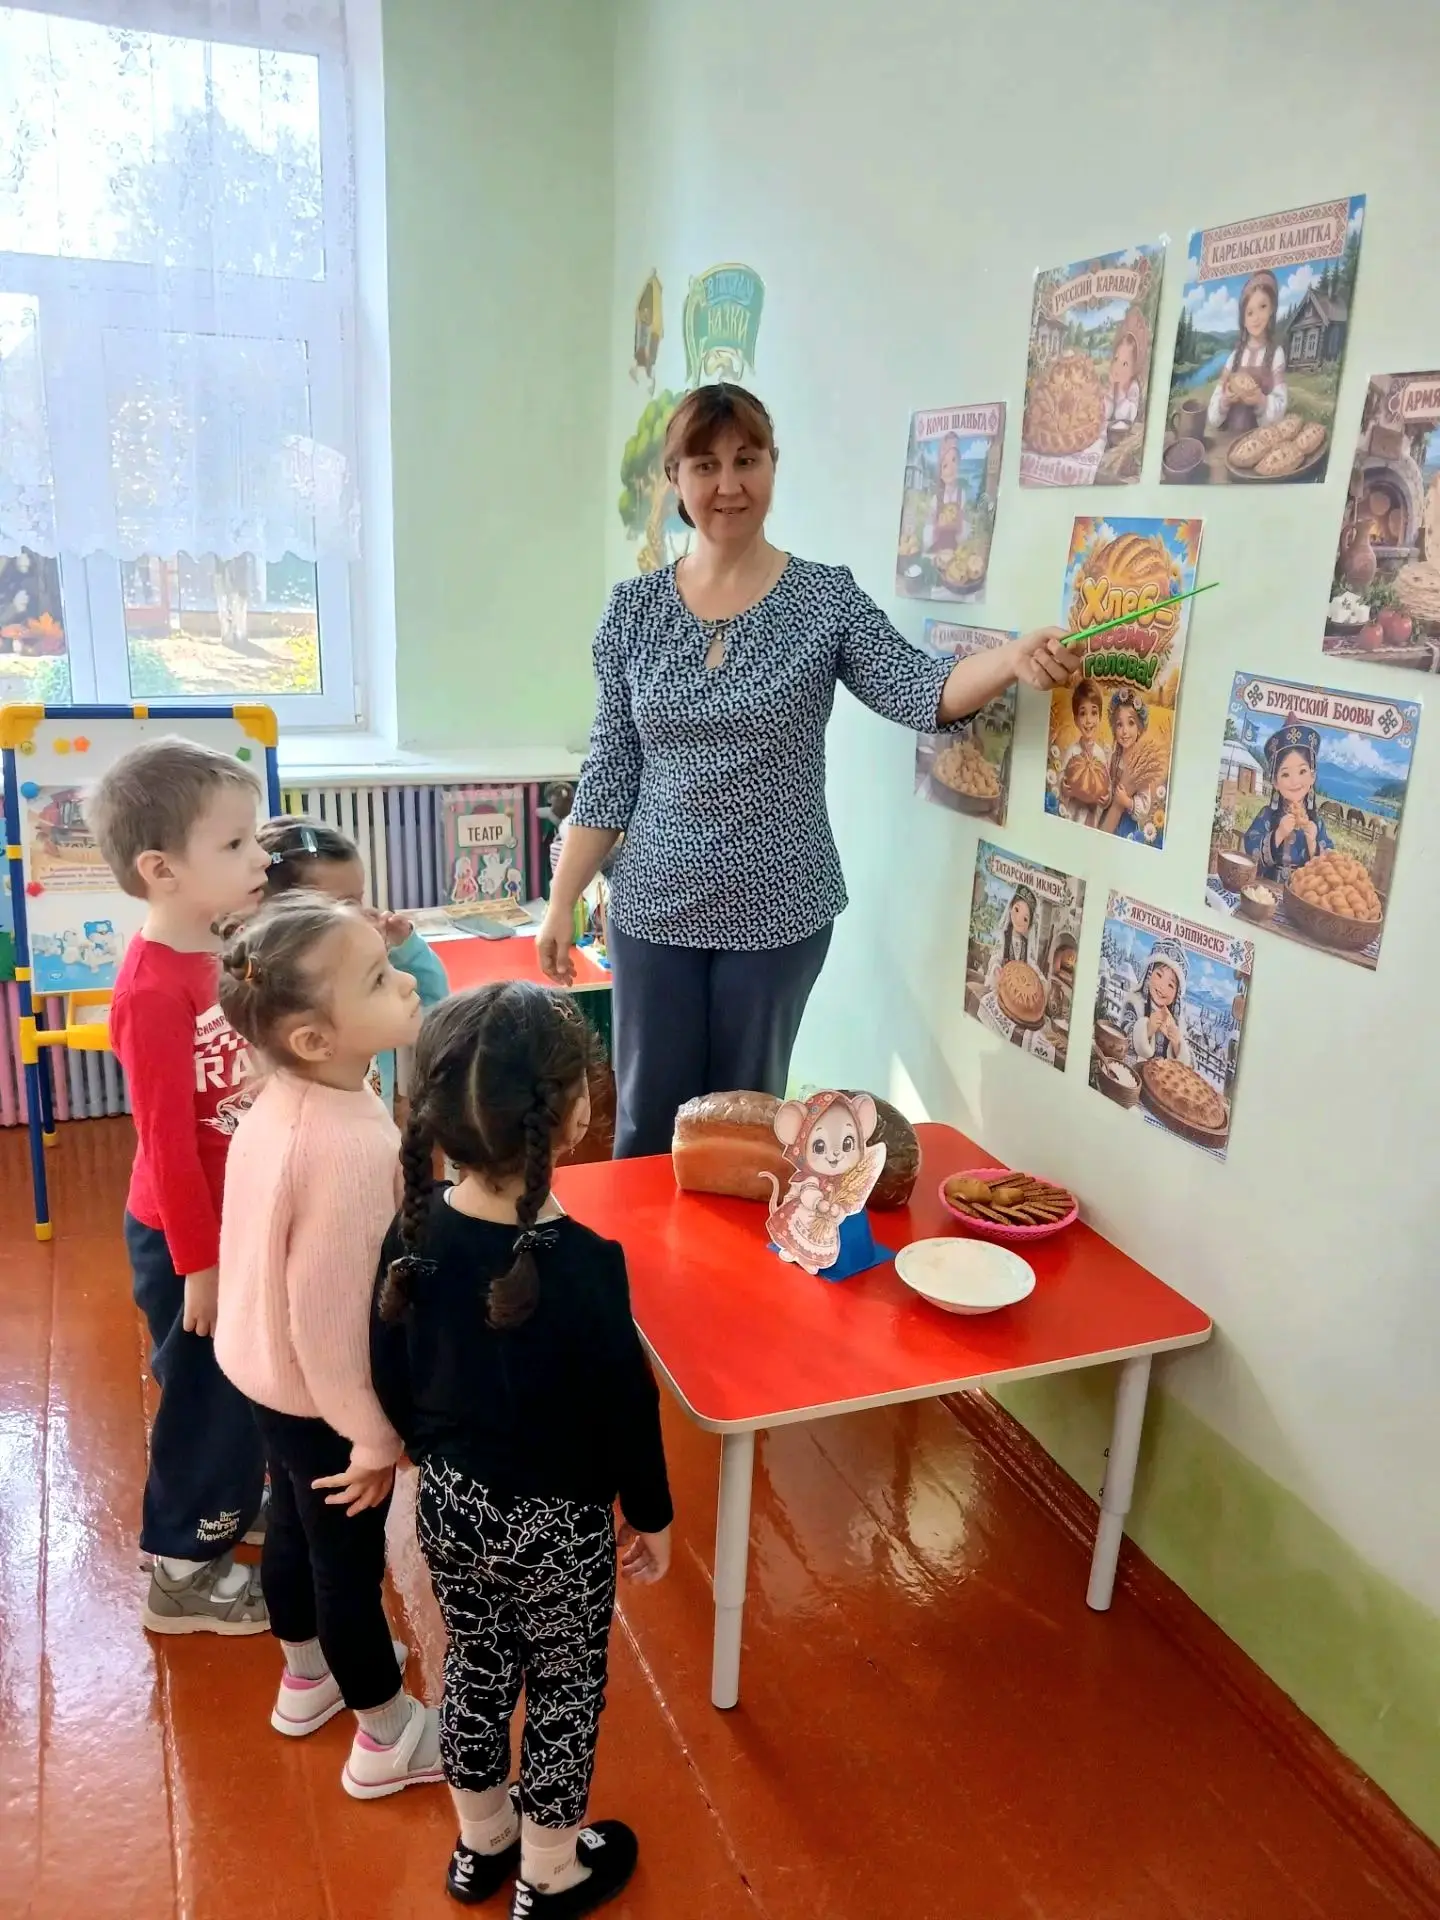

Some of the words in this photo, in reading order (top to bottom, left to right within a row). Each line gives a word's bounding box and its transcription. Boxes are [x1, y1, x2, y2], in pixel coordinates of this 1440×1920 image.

[1212, 234, 1276, 264] КАРЕЛЬСКАЯ
[1279, 223, 1331, 249] КАЛИТКА
[1054, 275, 1093, 312] РУССКИЙ
[1096, 273, 1138, 295] КАРАВАЙ
[926, 415, 949, 435] КОМИ
[951, 412, 987, 431] ШАНЬГА
[1266, 690, 1329, 719] БУРЯТСКИЙ
[1332, 702, 1375, 727] БООВЫ
[467, 825, 503, 842] ТЕАТР
[995, 859, 1034, 886] ТАТАРСКИЙ
[1036, 877, 1062, 898] ИКМЭК
[1130, 906, 1172, 934] ЯКУТСКАЯ
[1174, 922, 1225, 954] ЛЭППИЭСКЭ
